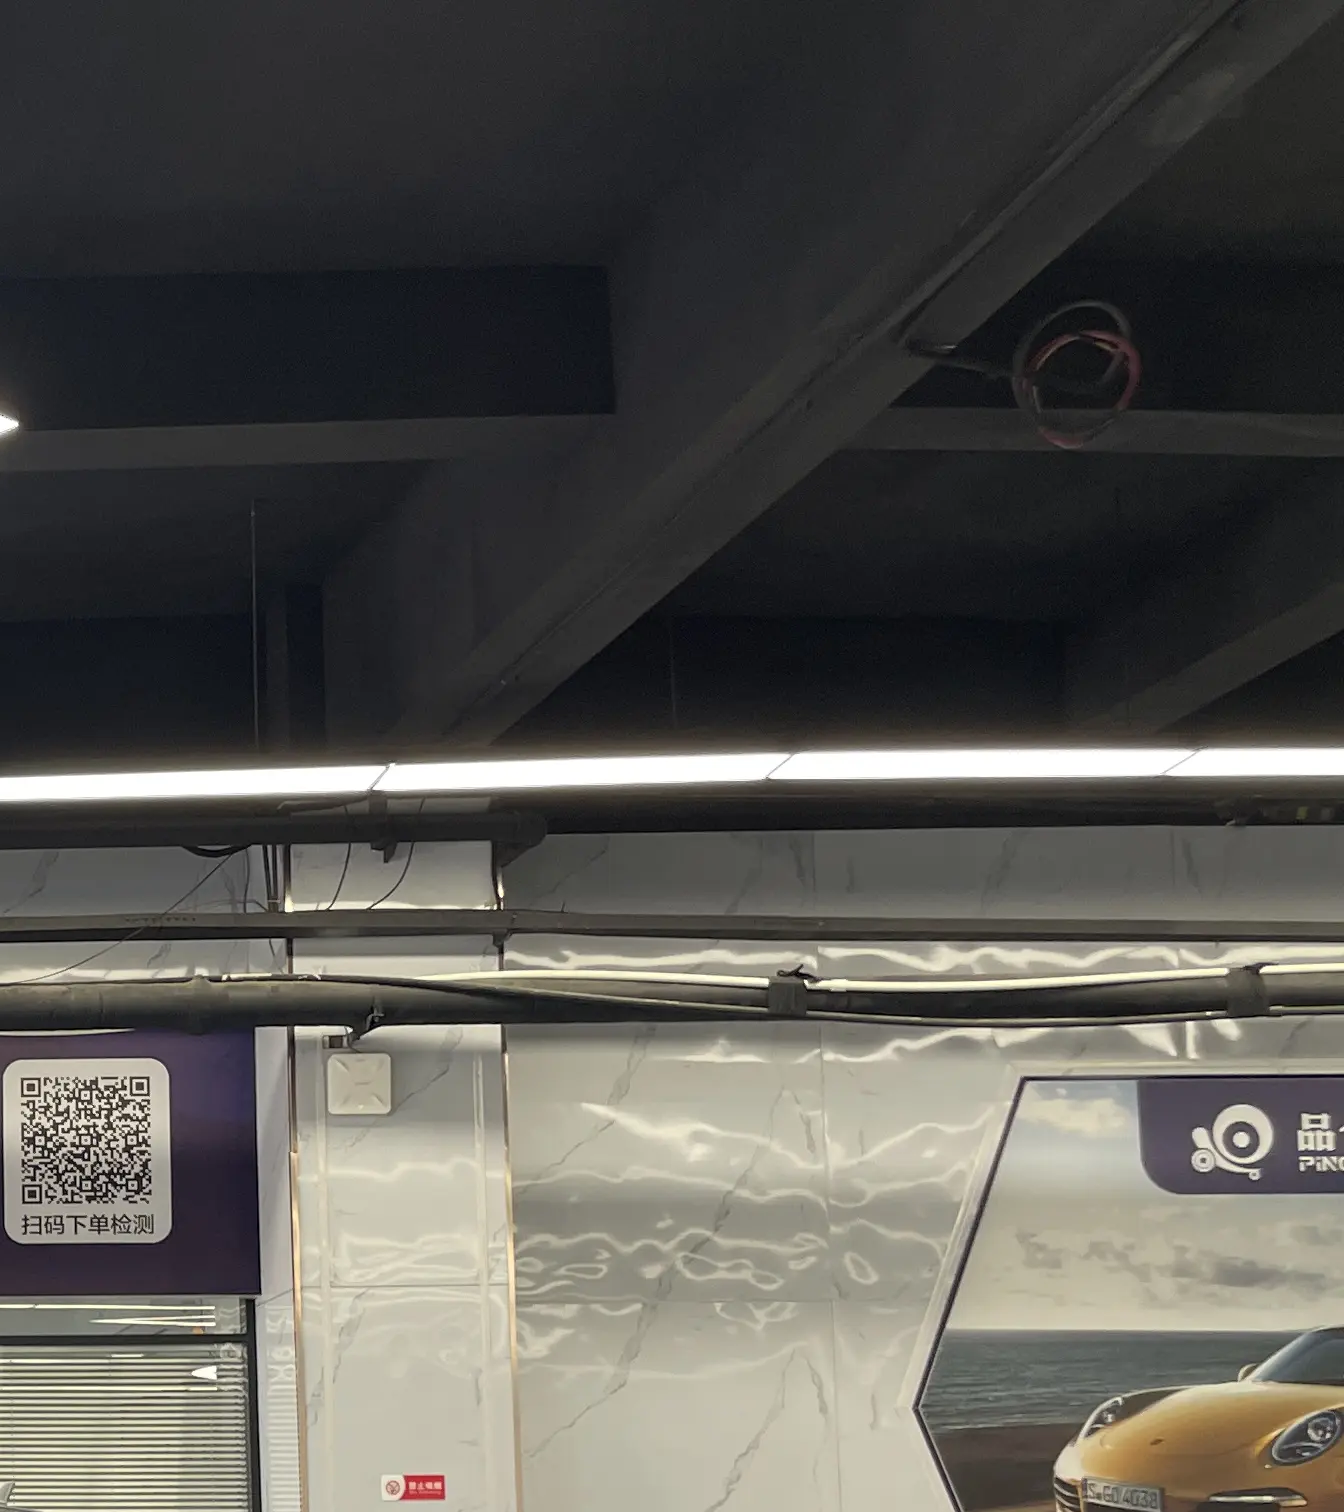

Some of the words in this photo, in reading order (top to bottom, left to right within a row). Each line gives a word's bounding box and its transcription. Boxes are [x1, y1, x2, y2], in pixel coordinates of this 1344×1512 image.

[1297, 1112, 1344, 1152] 品
[21, 1213, 155, 1236] 扫码下单检测
